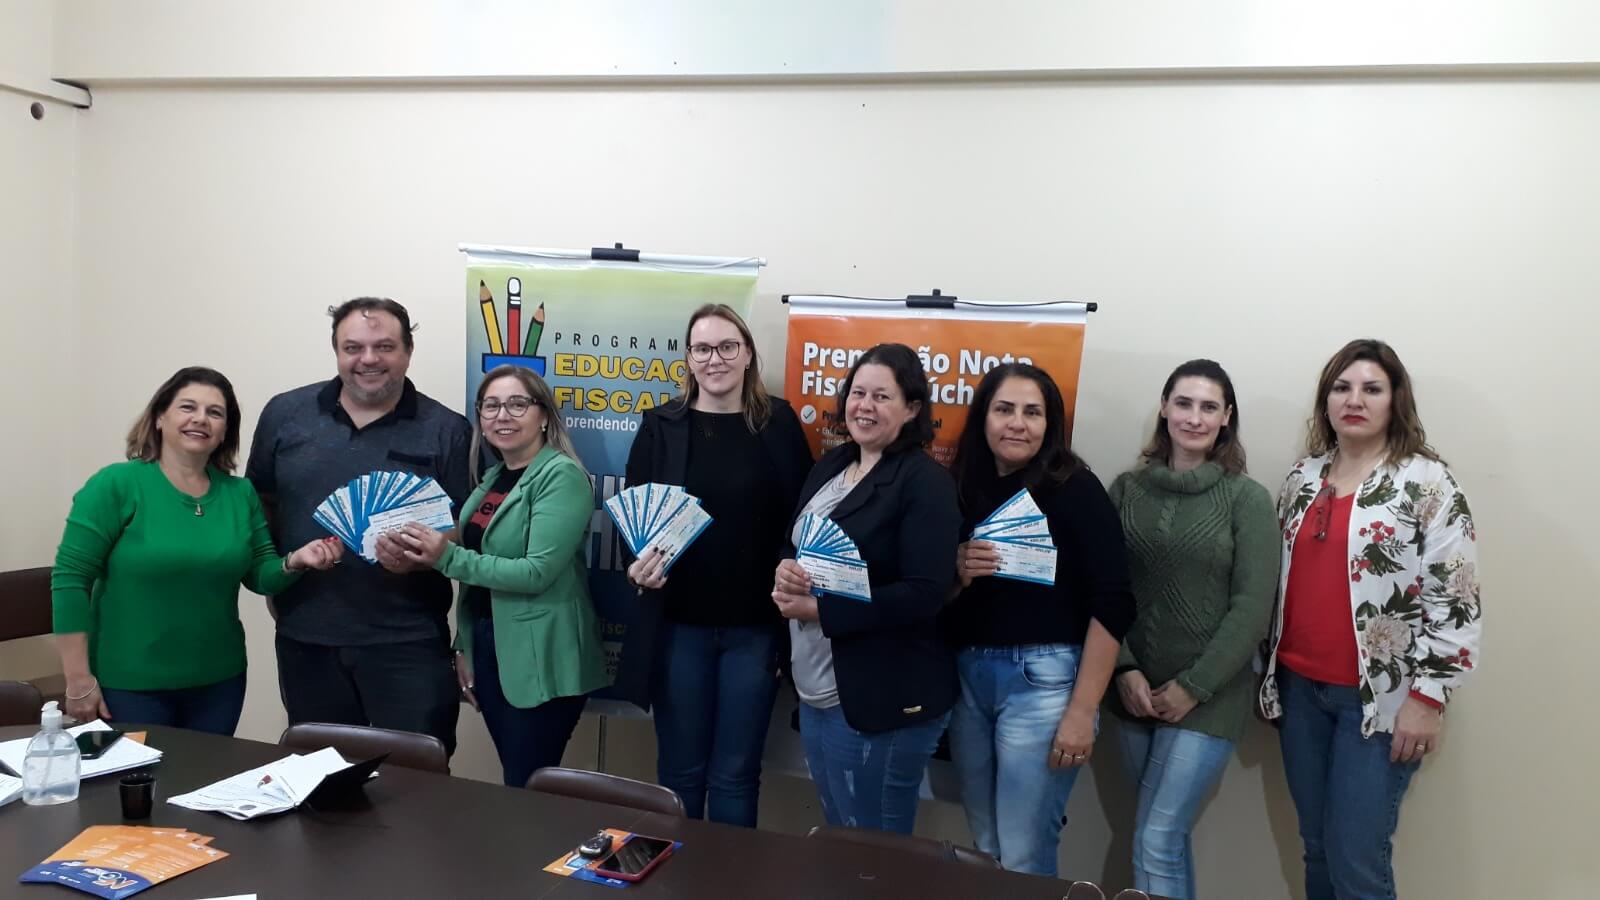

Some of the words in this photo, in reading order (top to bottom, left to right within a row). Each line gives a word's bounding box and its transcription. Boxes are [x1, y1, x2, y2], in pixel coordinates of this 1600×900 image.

[555, 332, 679, 351] PROGRAM
[554, 352, 688, 388] EDUCAÇ
[566, 416, 637, 432] prendendo
